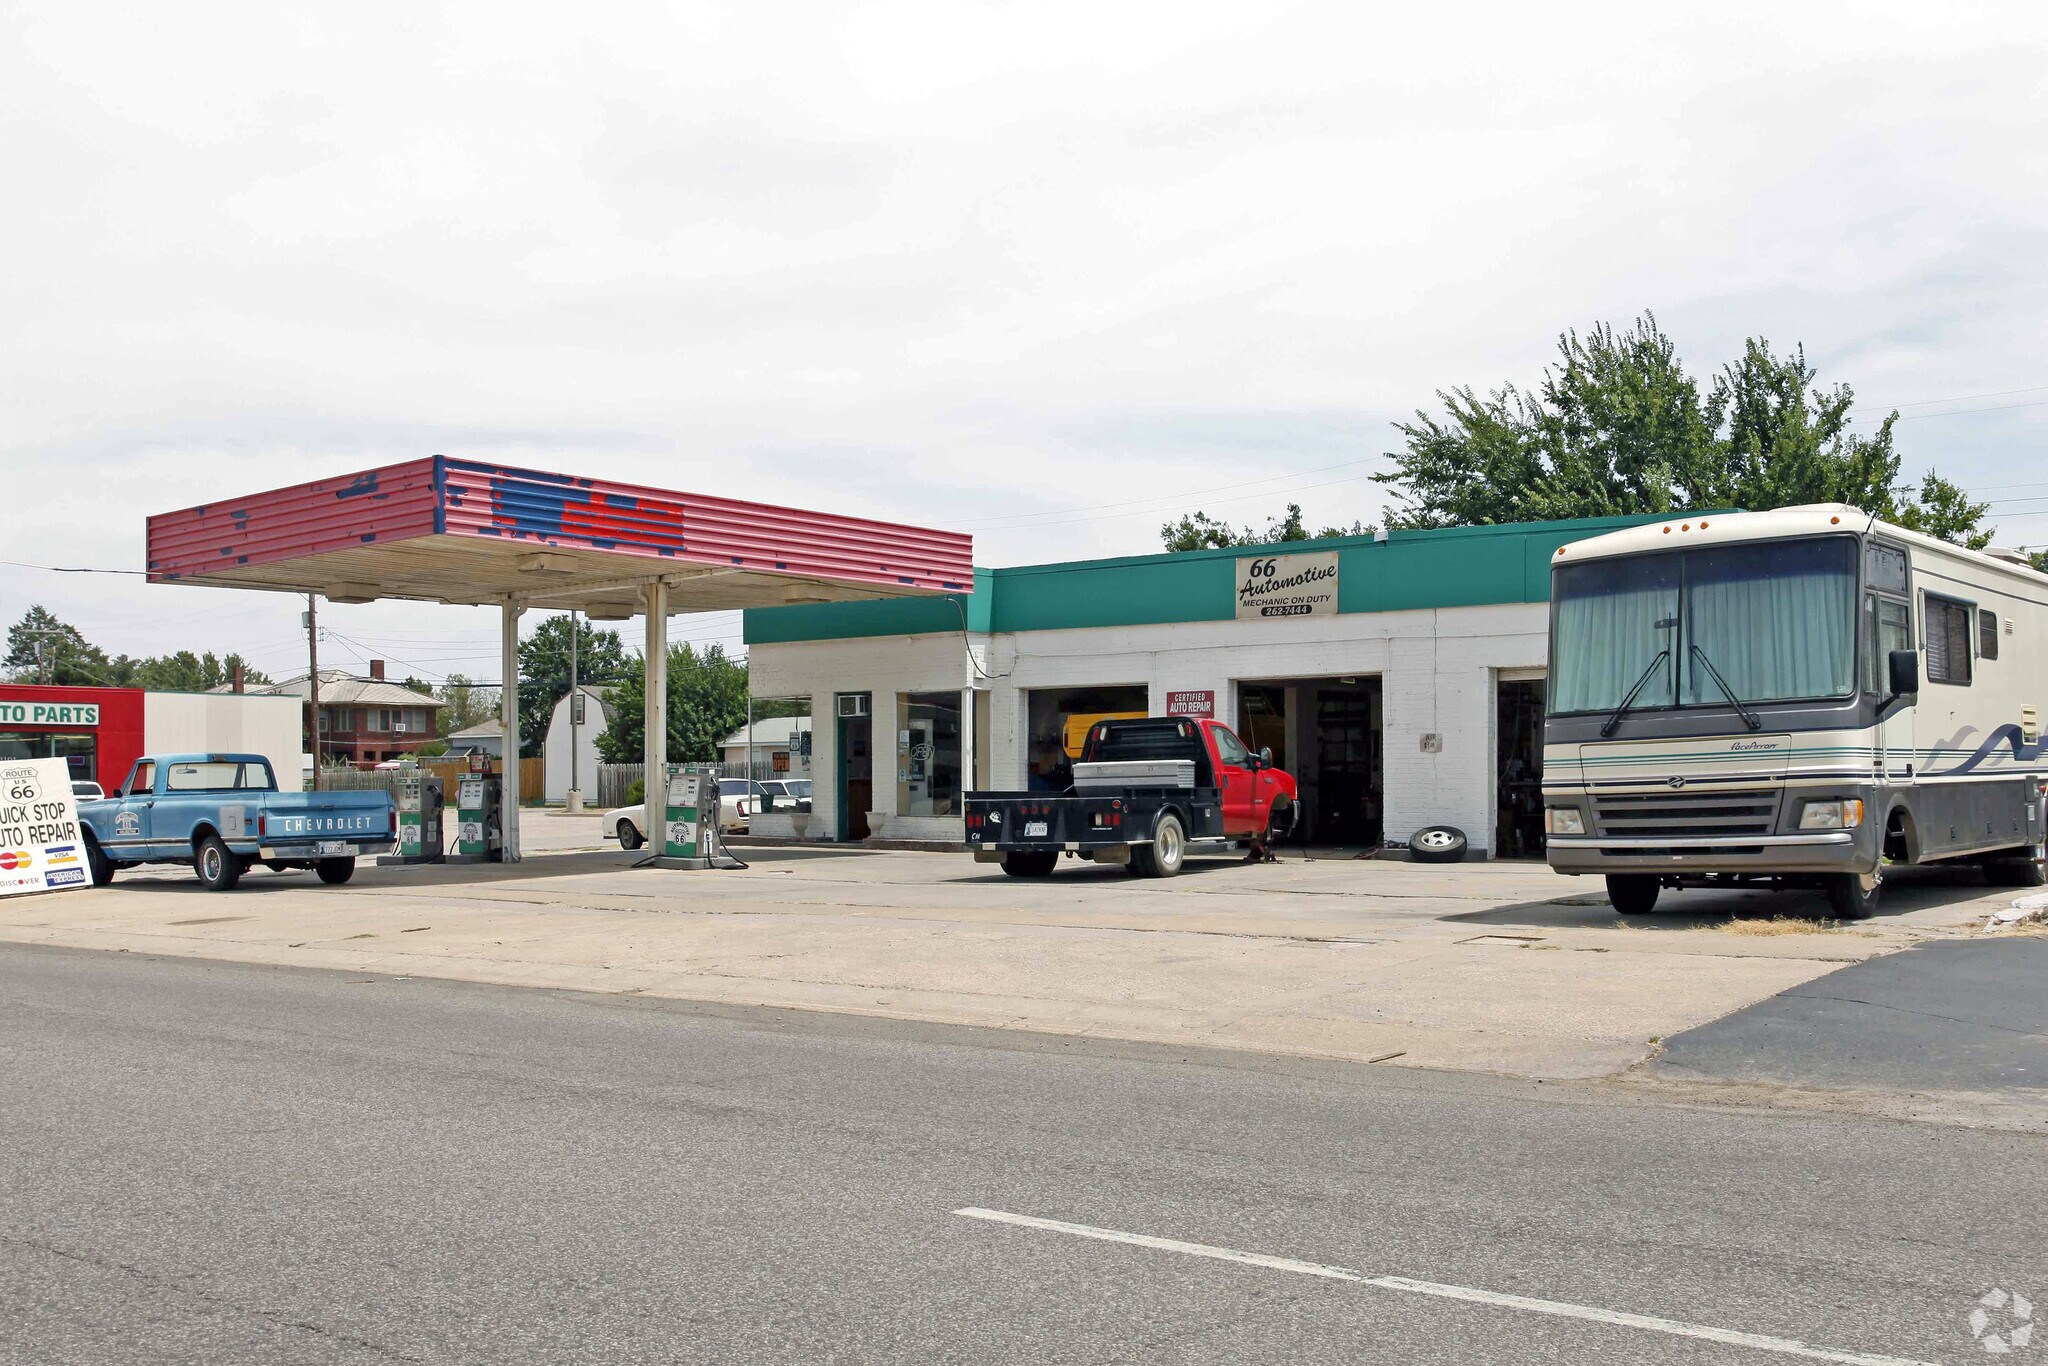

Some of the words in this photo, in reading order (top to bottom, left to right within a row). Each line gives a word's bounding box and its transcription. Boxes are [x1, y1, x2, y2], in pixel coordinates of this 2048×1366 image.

[1250, 559, 1276, 577] 66
[1240, 565, 1337, 600] Automotive
[1243, 598, 1288, 607] MECHANIC
[1307, 595, 1331, 603] DUTY
[1266, 604, 1308, 615] 262-7444
[1174, 693, 1206, 702] CERTIFIED
[1170, 702, 1187, 713] AUTO
[1188, 701, 1211, 712] REPAIR
[34, 706, 97, 723] PARTS
[911, 746, 935, 758] OPEN
[6, 769, 33, 777] ROUTE
[11, 785, 34, 799] 66
[33, 802, 65, 821] STOP
[285, 817, 371, 832] CHEVROLET
[28, 822, 77, 844] REPAIR
[675, 834, 685, 843] 66
